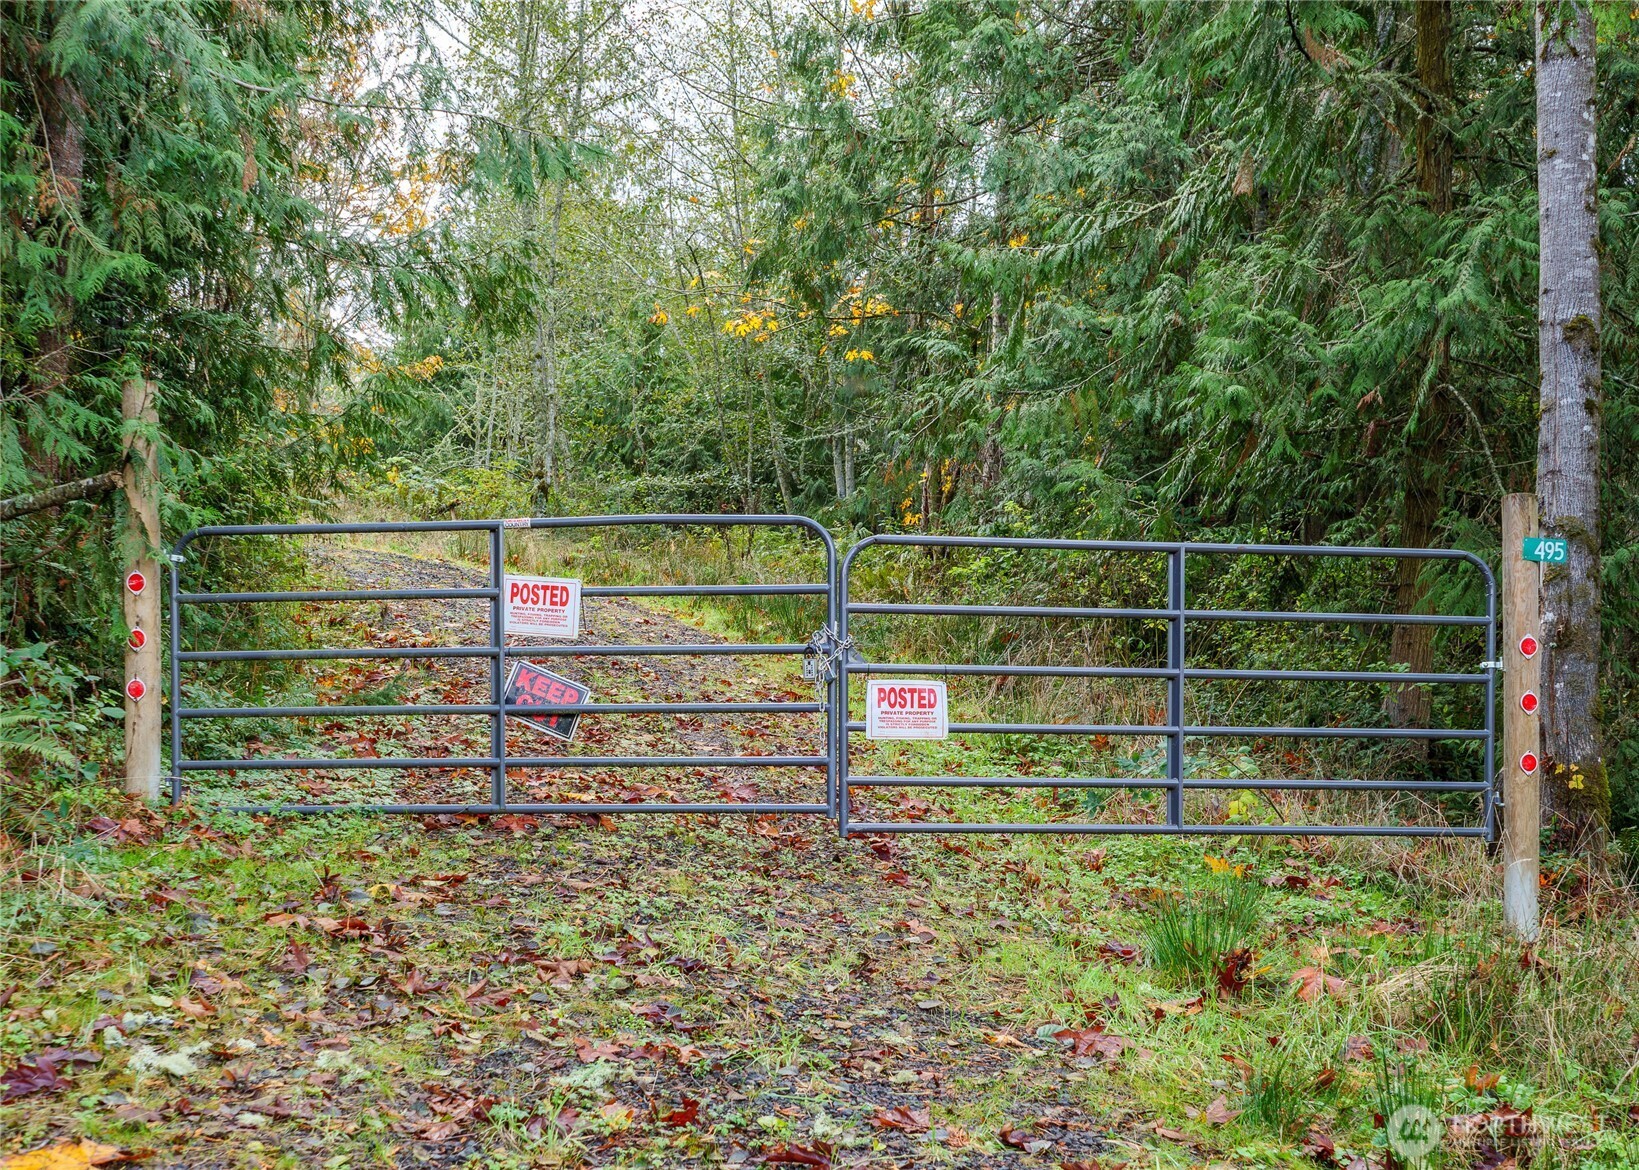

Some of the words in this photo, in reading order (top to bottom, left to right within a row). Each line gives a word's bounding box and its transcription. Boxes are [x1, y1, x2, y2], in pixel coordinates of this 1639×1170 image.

[1534, 541, 1564, 560] 495
[510, 583, 569, 606] POSTED
[516, 668, 578, 705] KEEP
[877, 687, 937, 709] POSTED
